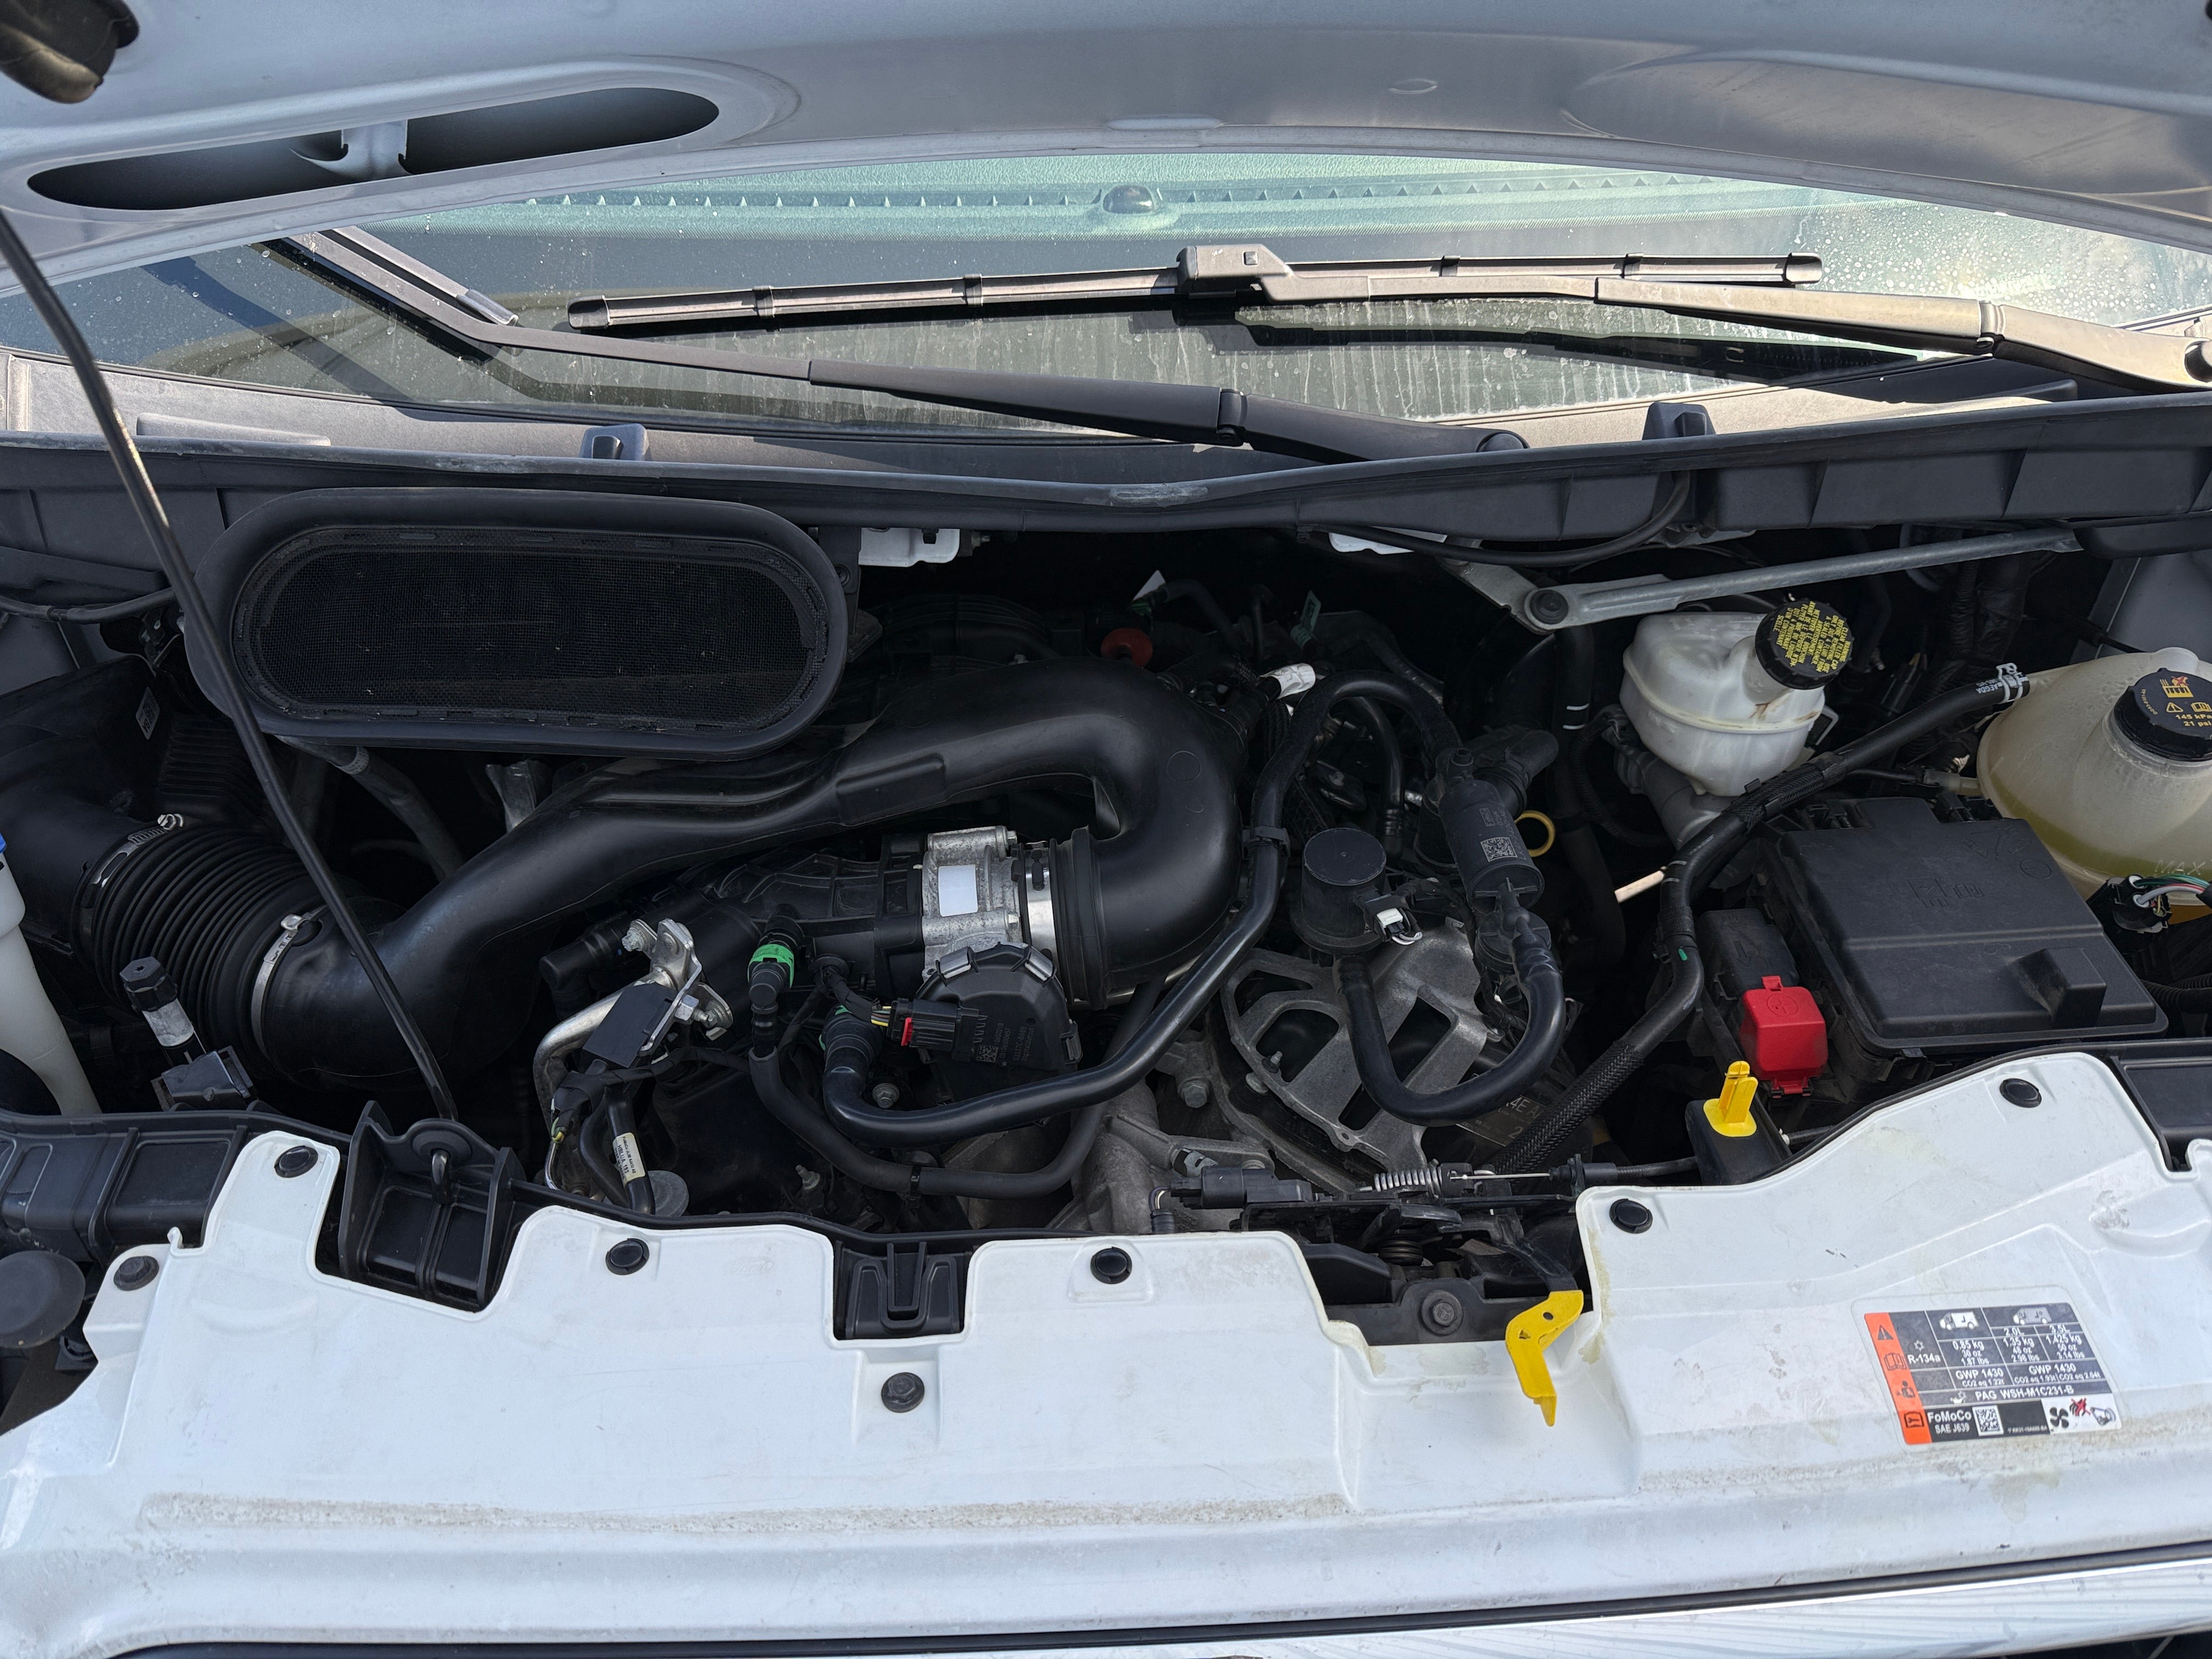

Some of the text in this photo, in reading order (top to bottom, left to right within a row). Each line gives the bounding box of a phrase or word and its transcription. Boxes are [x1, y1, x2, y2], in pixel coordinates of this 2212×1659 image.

[1798, 603, 1808, 621] PLOYER
[1806, 601, 1815, 616] AVANT
[1808, 608, 1820, 631] NETTOYER
[1830, 615, 1838, 627] ONLY
[1794, 622, 1802, 631] QUE
[1820, 621, 1830, 638] SEALED
[1826, 628, 1835, 637] DOT
[1833, 619, 1844, 636] BEFORE
[1785, 640, 1796, 659] LIQUIDE
[1797, 641, 1810, 663] BOUCHON
[1816, 658, 1825, 672] FROM
[1821, 663, 1830, 673] USE
[1830, 659, 1838, 669] CAP
[2155, 860, 2205, 875] MAX
[1973, 1340, 1985, 1351] kg
[2023, 1336, 2034, 1348] kg
[2070, 1334, 2082, 1345] kg
[1907, 1353, 1941, 1364] R-134a
[1955, 1368, 2004, 1380] GWP 1430
[2029, 1363, 2076, 1375] GWP 1430
[1975, 1385, 2074, 1401] PAG WSH-M1C231-B
[1927, 1410, 1972, 1424] FoMoCo
[1935, 1423, 1970, 1434] SAE J639
